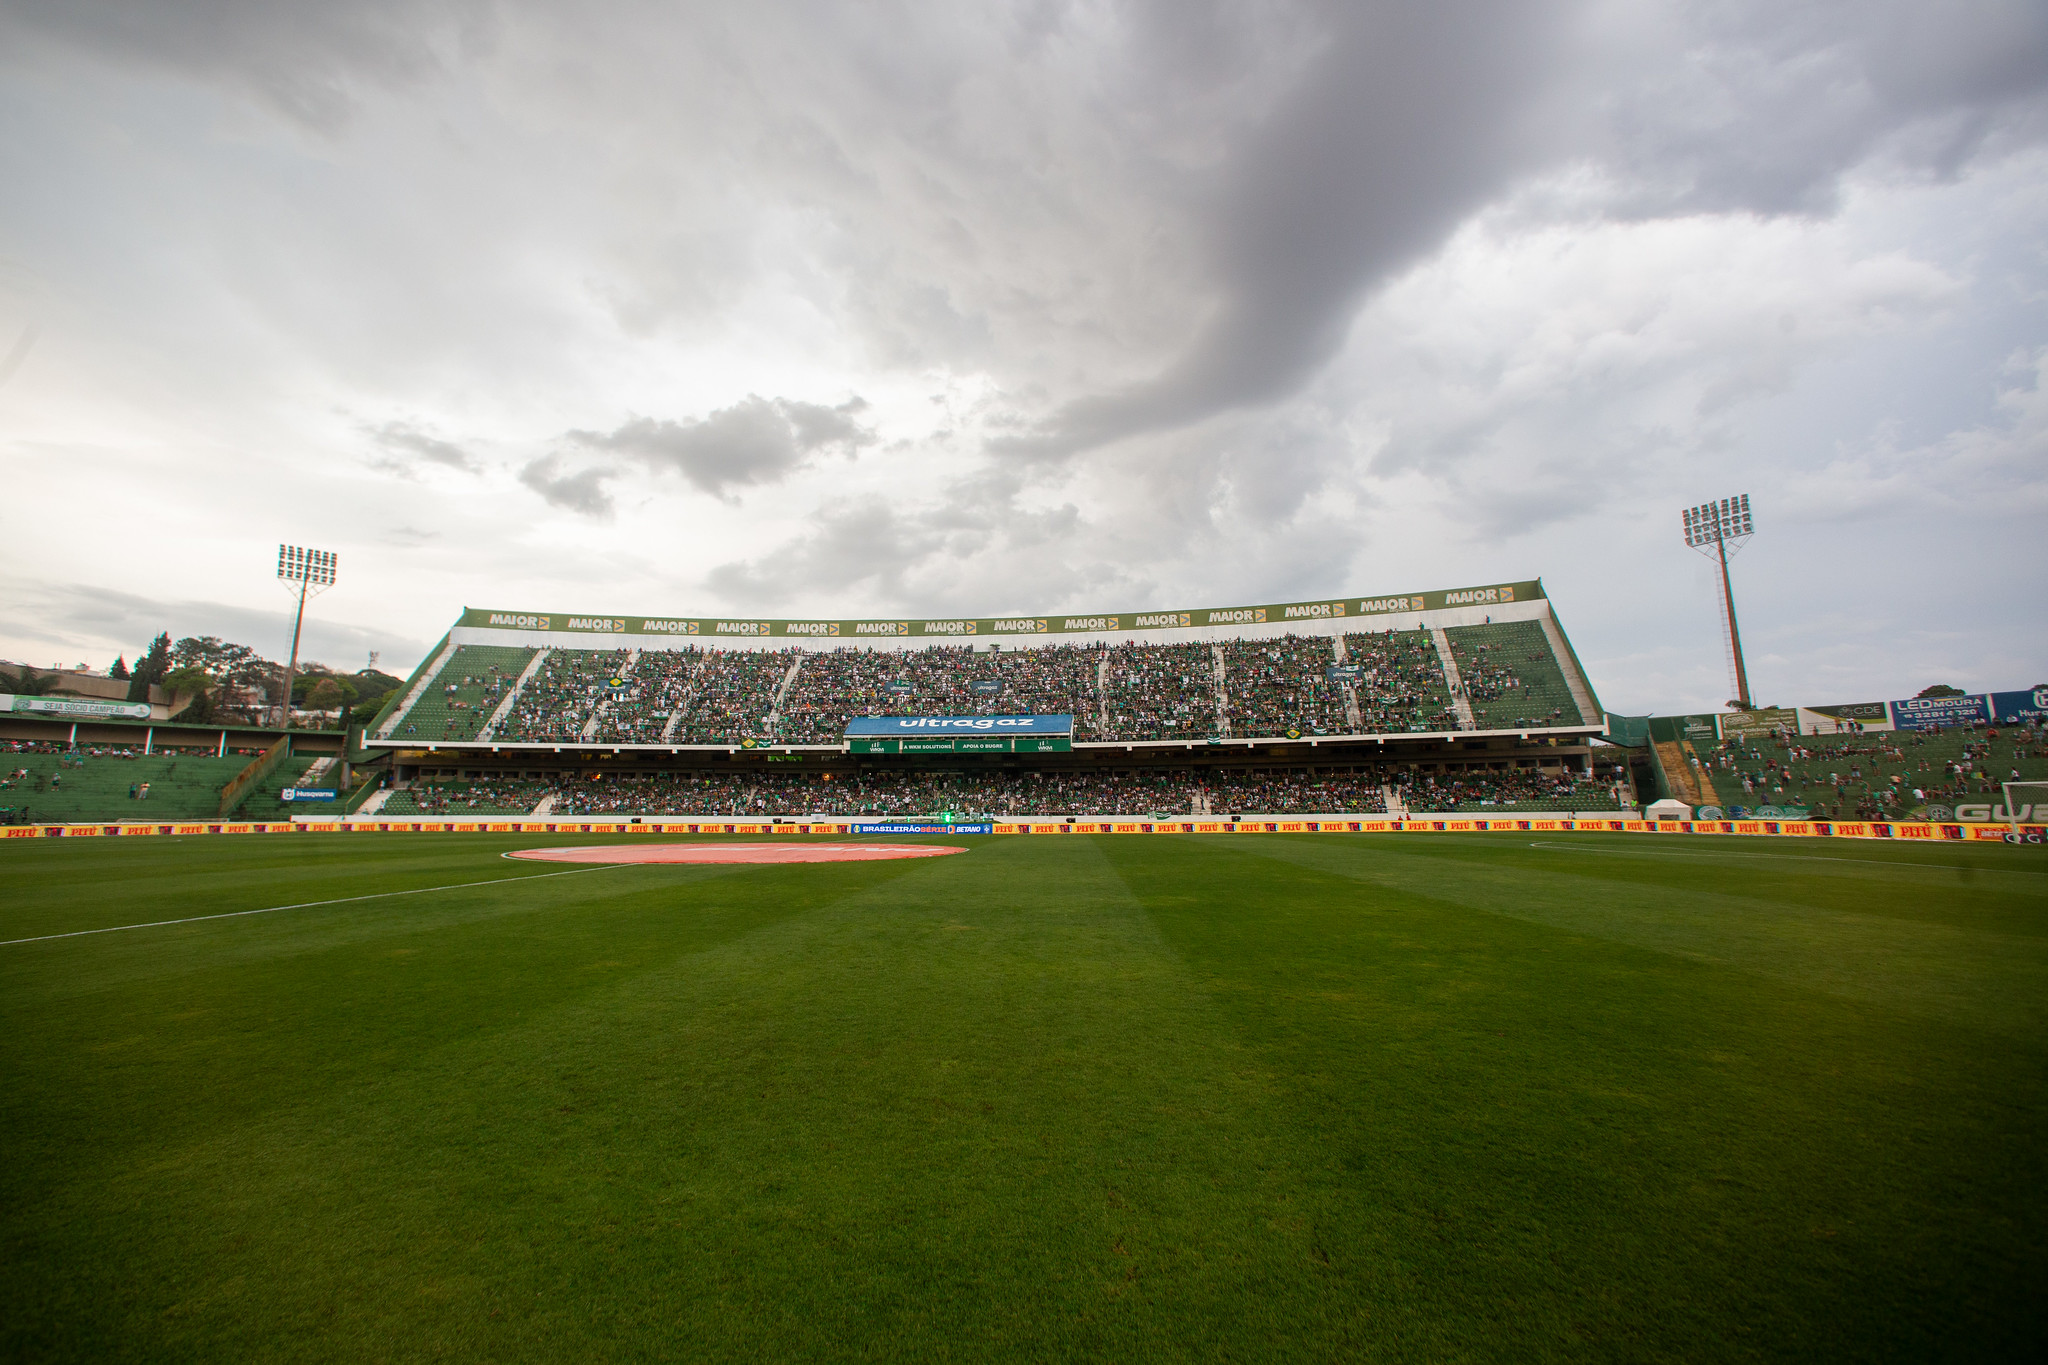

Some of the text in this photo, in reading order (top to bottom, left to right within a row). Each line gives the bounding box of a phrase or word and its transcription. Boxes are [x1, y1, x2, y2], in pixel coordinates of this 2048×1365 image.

[1446, 589, 1498, 604] MAIOR
[1360, 598, 1409, 612] MAIOR
[1209, 610, 1253, 622] MAIOR
[1285, 605, 1331, 617] MAIOR
[490, 614, 537, 626] MAIOR
[568, 618, 612, 629] MAIOR
[1065, 618, 1106, 629] MAIOR
[1136, 615, 1178, 626] MAIOR
[643, 621, 687, 631] MAIOR
[716, 623, 758, 633] MAIOR
[787, 624, 827, 633] MAIOR
[856, 623, 897, 633] MAIOR
[925, 622, 965, 632] MAIOR
[994, 620, 1035, 631] MAIOR
[44, 702, 62, 710] SEJA
[90, 704, 125, 713] CAMPEÃO
[1853, 706, 1880, 714] CDE
[1897, 700, 1933, 711] LED
[1933, 699, 1982, 708] MOURA
[900, 718, 1034, 729] ultragaz
[995, 825, 1013, 833] PITÚ
[1035, 824, 1054, 832] PITÚ
[1076, 824, 1094, 832] PITÚ
[1117, 824, 1135, 832] PITÚ
[1158, 824, 1176, 832] PITÚ
[1200, 824, 1218, 832] PITÚ
[1241, 823, 1259, 831] PITÚ
[1283, 823, 1301, 831] PITÚ
[1324, 823, 1343, 831] PITÚ
[1366, 821, 1385, 831] PITÚ
[1409, 821, 1427, 830] PITÚ
[1451, 821, 1469, 830] PITÚ
[1493, 821, 1512, 830] PITÚ
[1536, 821, 1555, 830] PITÚ
[1581, 821, 1603, 830] PITÚ
[1627, 821, 1642, 830] PITÚ
[1660, 821, 1676, 831] PITÚ
[1698, 821, 1715, 832] PITÚ
[1739, 821, 1759, 832] PITÚ
[1785, 822, 1808, 833] PITÚ
[1838, 823, 1864, 835] PITÚ
[1900, 823, 1931, 837] PITÚ
